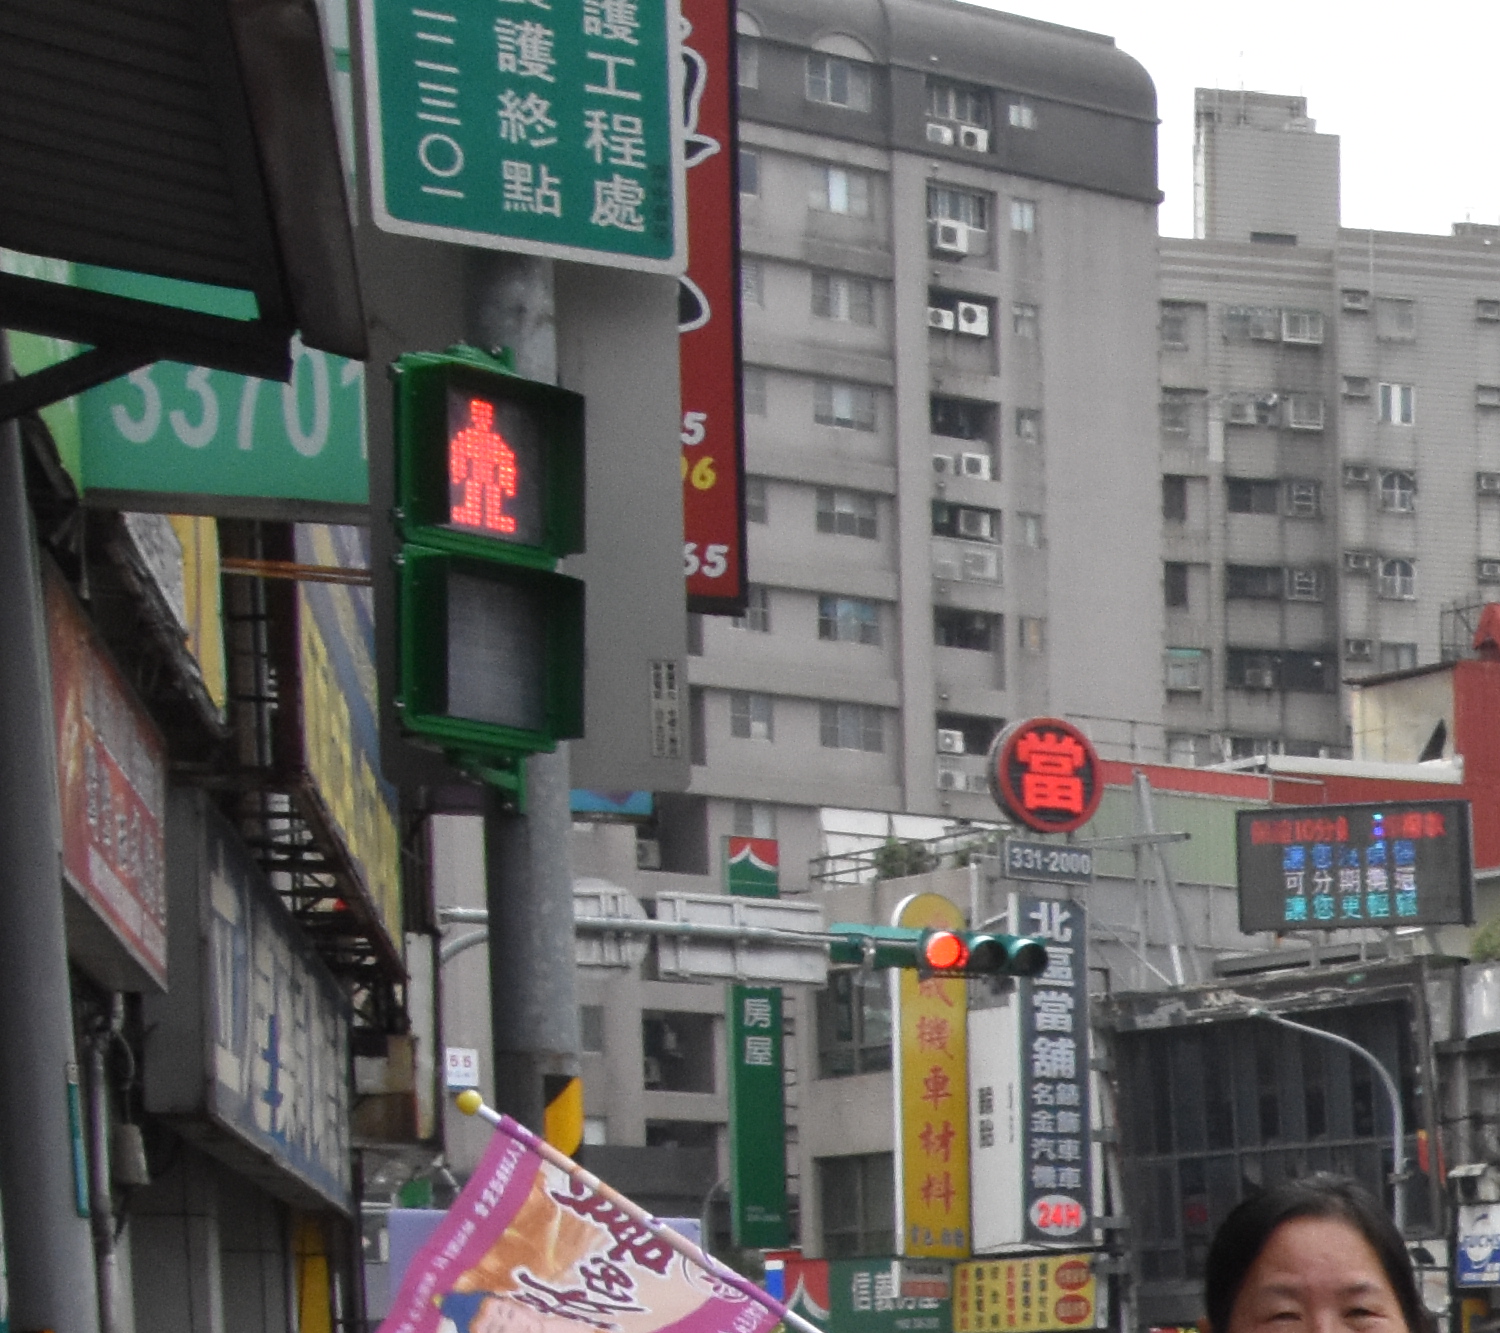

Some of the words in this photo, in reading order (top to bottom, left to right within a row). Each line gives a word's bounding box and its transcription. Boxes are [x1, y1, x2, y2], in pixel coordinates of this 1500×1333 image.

[494, 0, 561, 218] 護終點
[1017, 732, 1084, 813] 當
[1011, 848, 1091, 875] 331-2000
[1037, 1202, 1082, 1228] 24H
